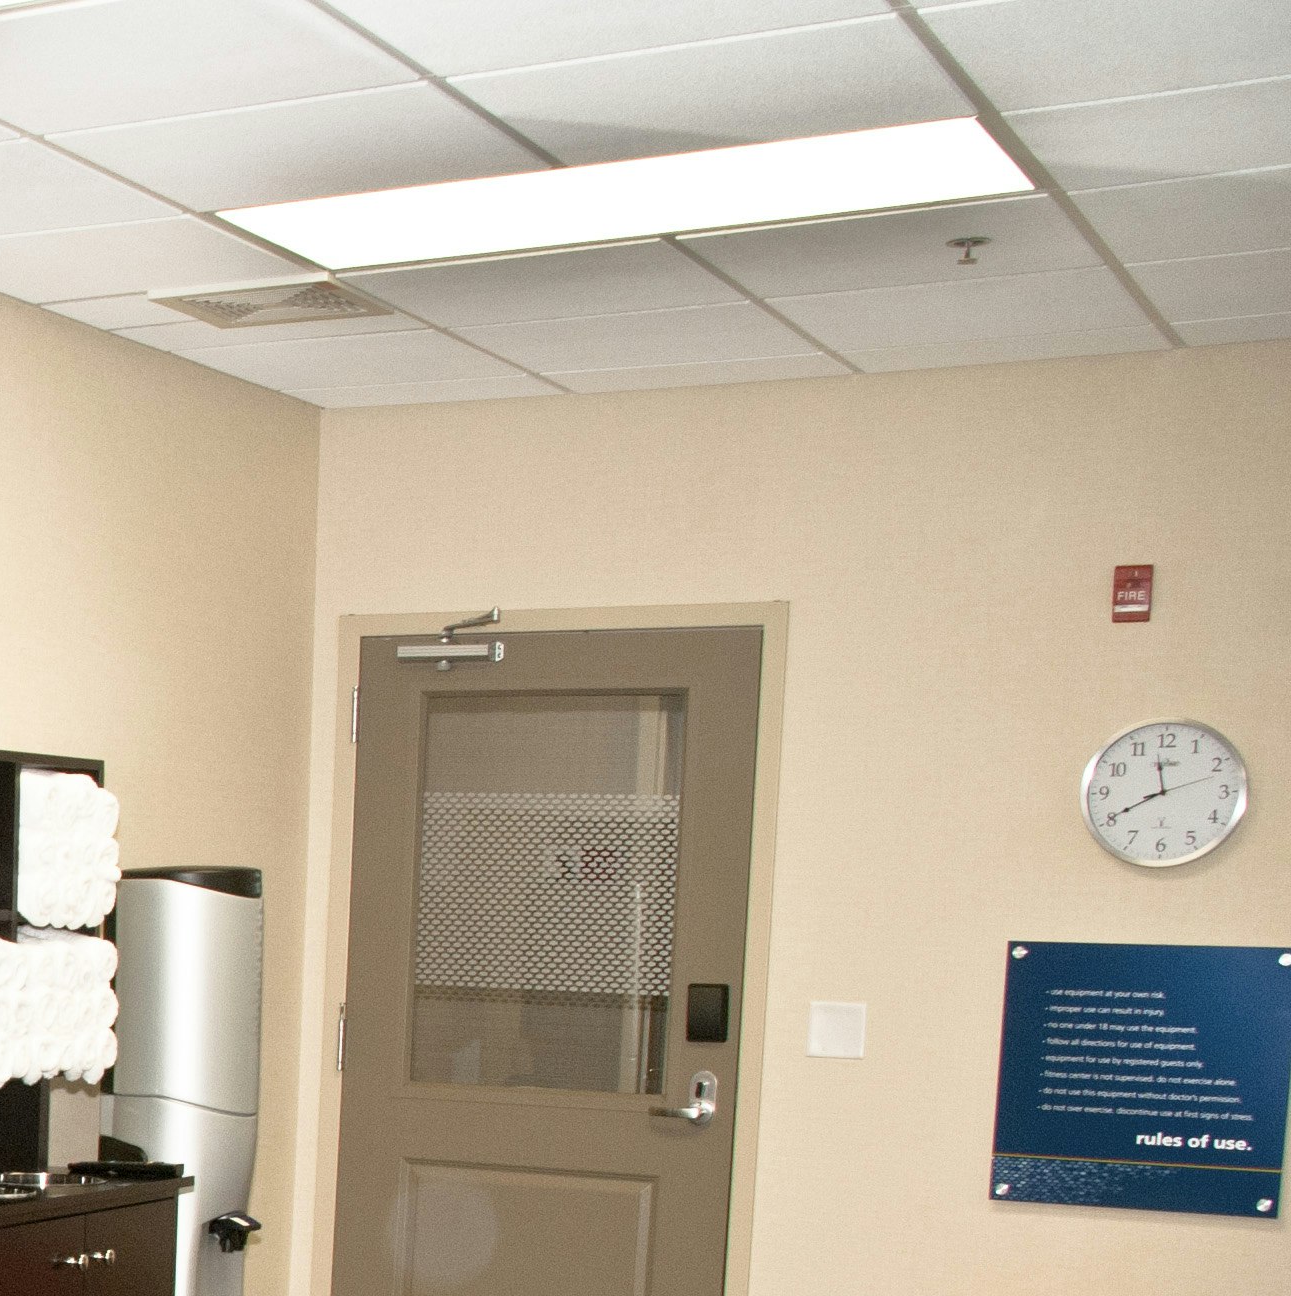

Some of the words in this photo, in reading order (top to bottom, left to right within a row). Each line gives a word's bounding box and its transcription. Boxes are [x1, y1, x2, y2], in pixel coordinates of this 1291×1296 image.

[1117, 590, 1147, 601] FIRE
[1157, 733, 1176, 748] 12
[1191, 739, 1200, 754] 1
[1131, 742, 1146, 756] 11
[1109, 762, 1126, 777] 10
[1211, 757, 1223, 772] 2
[1099, 785, 1109, 800] 9
[1219, 784, 1230, 800] 3
[1106, 812, 1117, 827] 8
[1207, 809, 1219, 823] 4
[1127, 830, 1139, 845] 7
[1155, 837, 1166, 852] 6
[1185, 830, 1196, 845] 5
[1135, 1131, 1183, 1148] rules
[1187, 1134, 1210, 1149] of
[1213, 1138, 1253, 1151] use.
